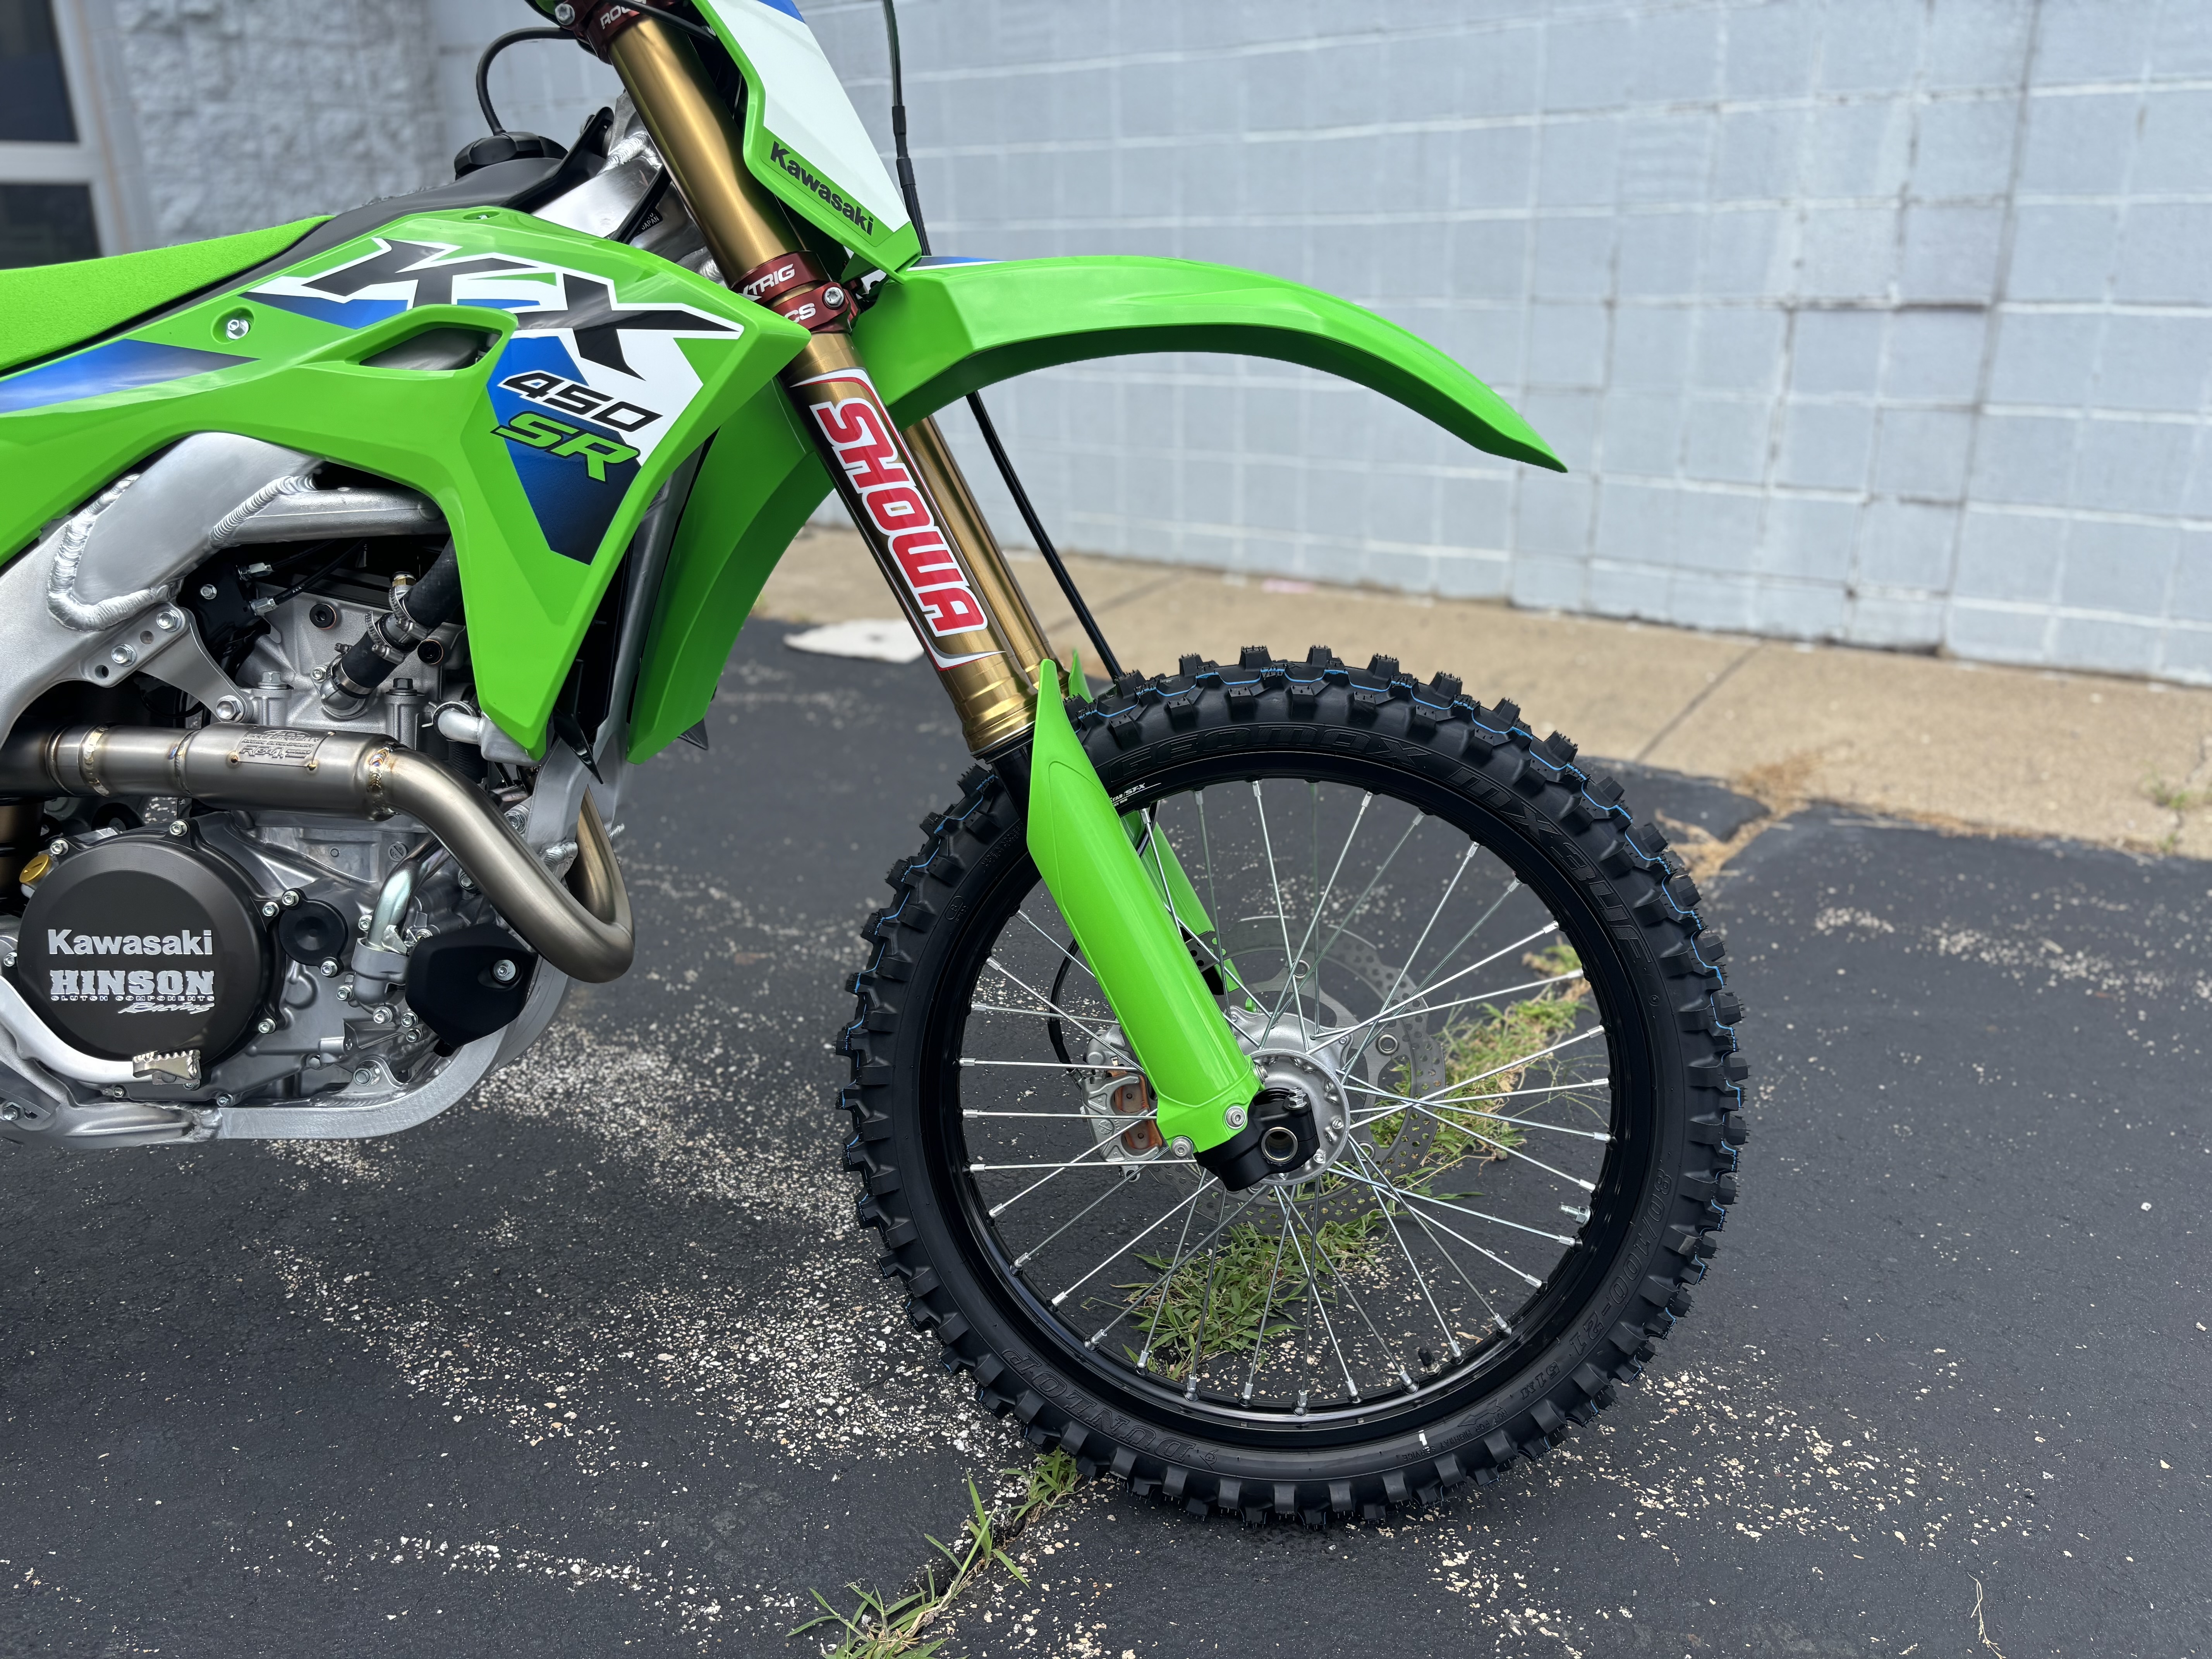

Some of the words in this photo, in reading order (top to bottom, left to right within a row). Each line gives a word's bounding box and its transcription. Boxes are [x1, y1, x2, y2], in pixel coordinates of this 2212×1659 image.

[770, 141, 874, 236] Kawasaki
[641, 215, 659, 230] JAPAN
[300, 237, 743, 381] KX
[500, 372, 663, 432] 450
[491, 410, 641, 484] SR
[809, 398, 988, 637] SHOWA
[1109, 725, 1431, 782] GEOMAX
[48, 929, 213, 955] Kawasaki
[50, 970, 214, 995] HINSON
[1001, 1349, 1196, 1463] DUNLOP
[1474, 1419, 1490, 1432] FOR
